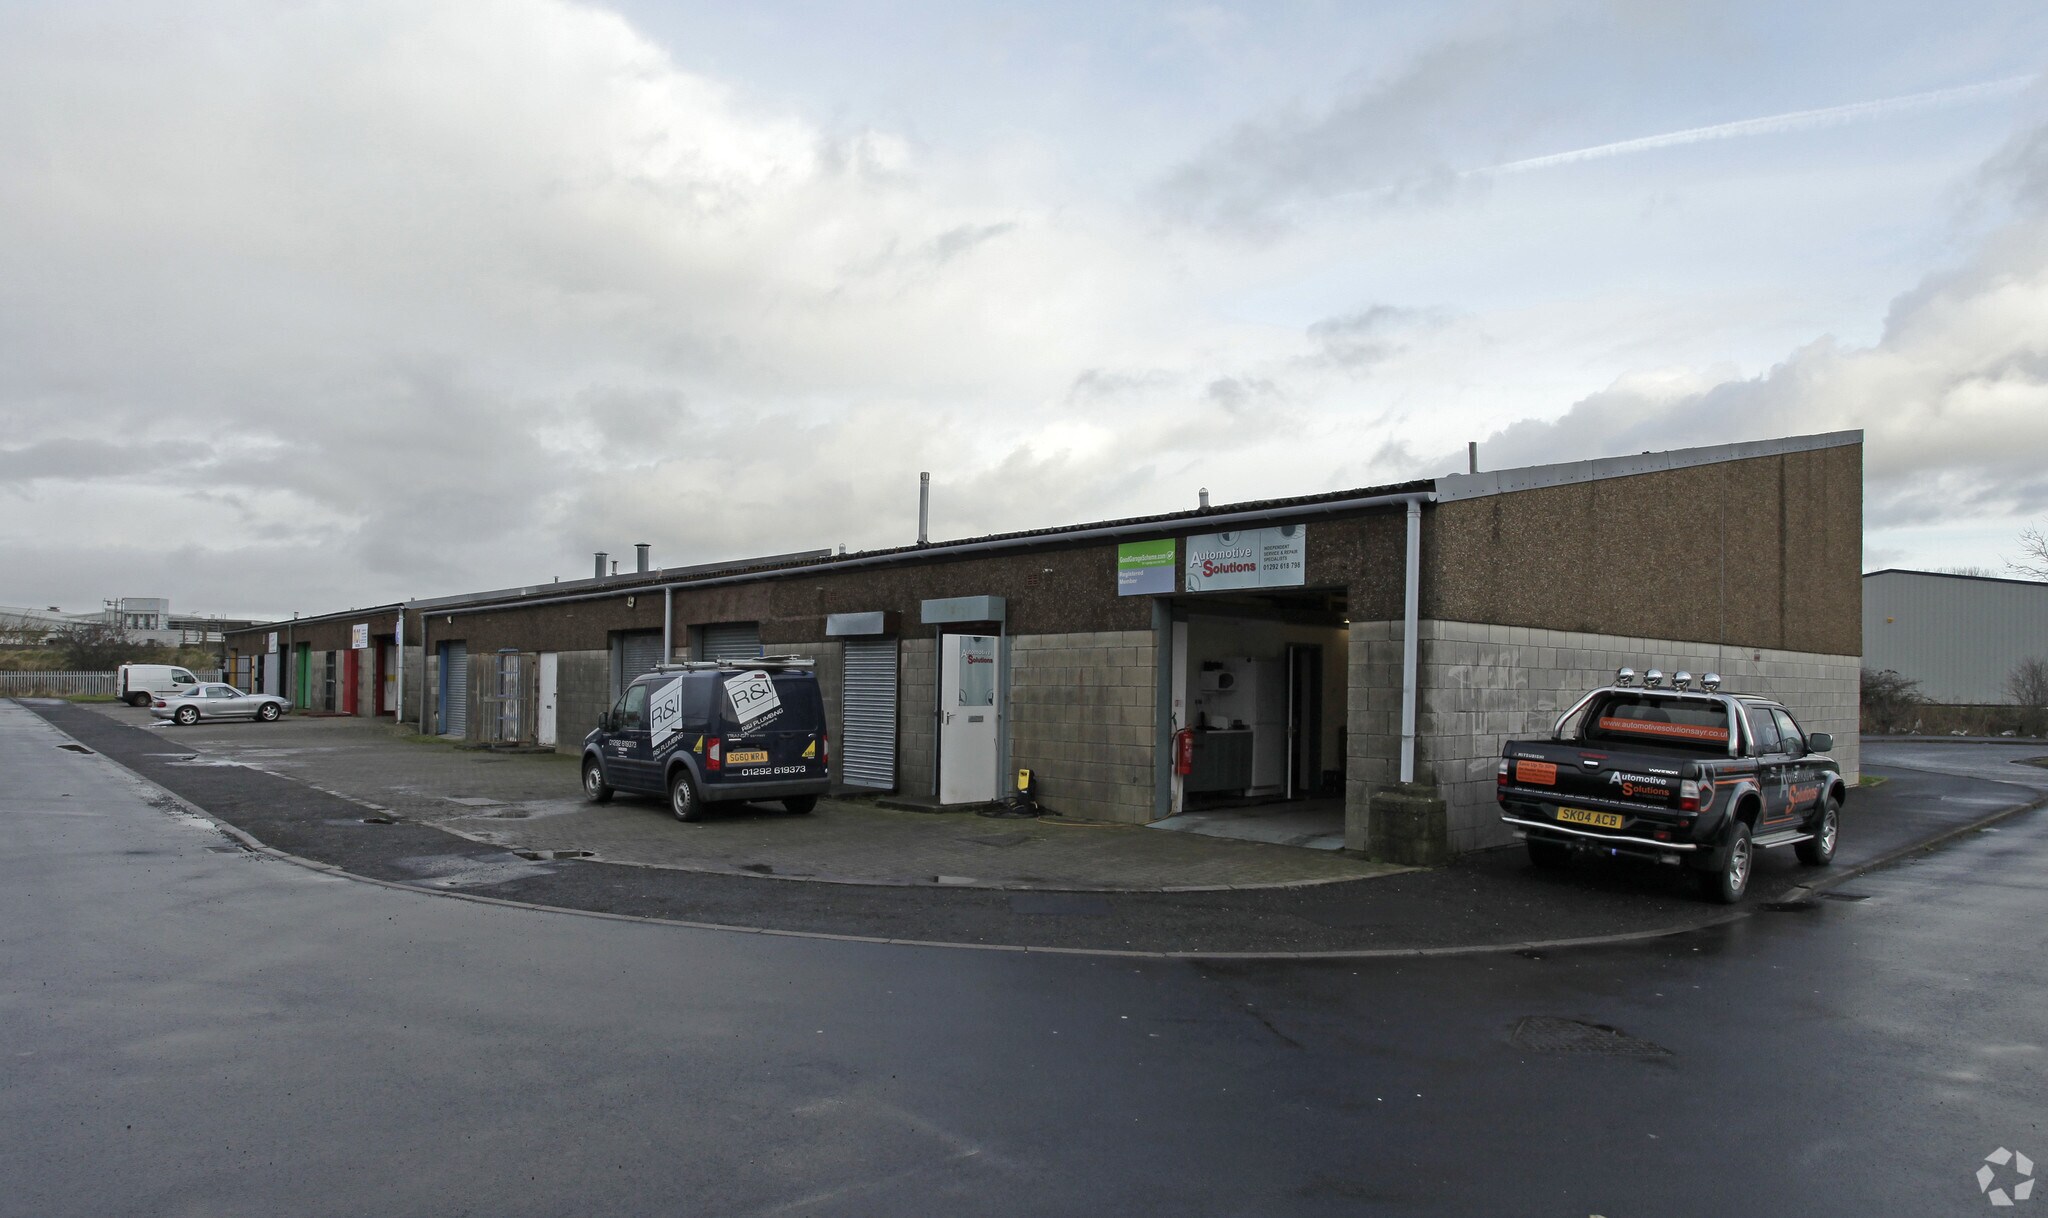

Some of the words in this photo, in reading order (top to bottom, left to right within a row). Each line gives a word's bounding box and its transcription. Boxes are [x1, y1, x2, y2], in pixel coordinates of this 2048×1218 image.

[1189, 547, 1252, 568] Automotive
[1119, 570, 1144, 578] Registered
[1202, 560, 1257, 577] Solutions
[1263, 563, 1279, 571] 01292
[967, 654, 993, 665] Solutions
[732, 679, 772, 709] R&I
[652, 694, 679, 728] R&I
[752, 707, 784, 727] PLUMBING
[729, 753, 749, 762] SG60
[742, 767, 772, 776] 01292
[774, 765, 806, 775] 619373
[1609, 771, 1667, 786] Automotive
[1622, 782, 1670, 796] Solutions
[1784, 784, 1820, 815] Solutions
[1562, 808, 1592, 823] SK04
[1594, 813, 1618, 827] ACB
